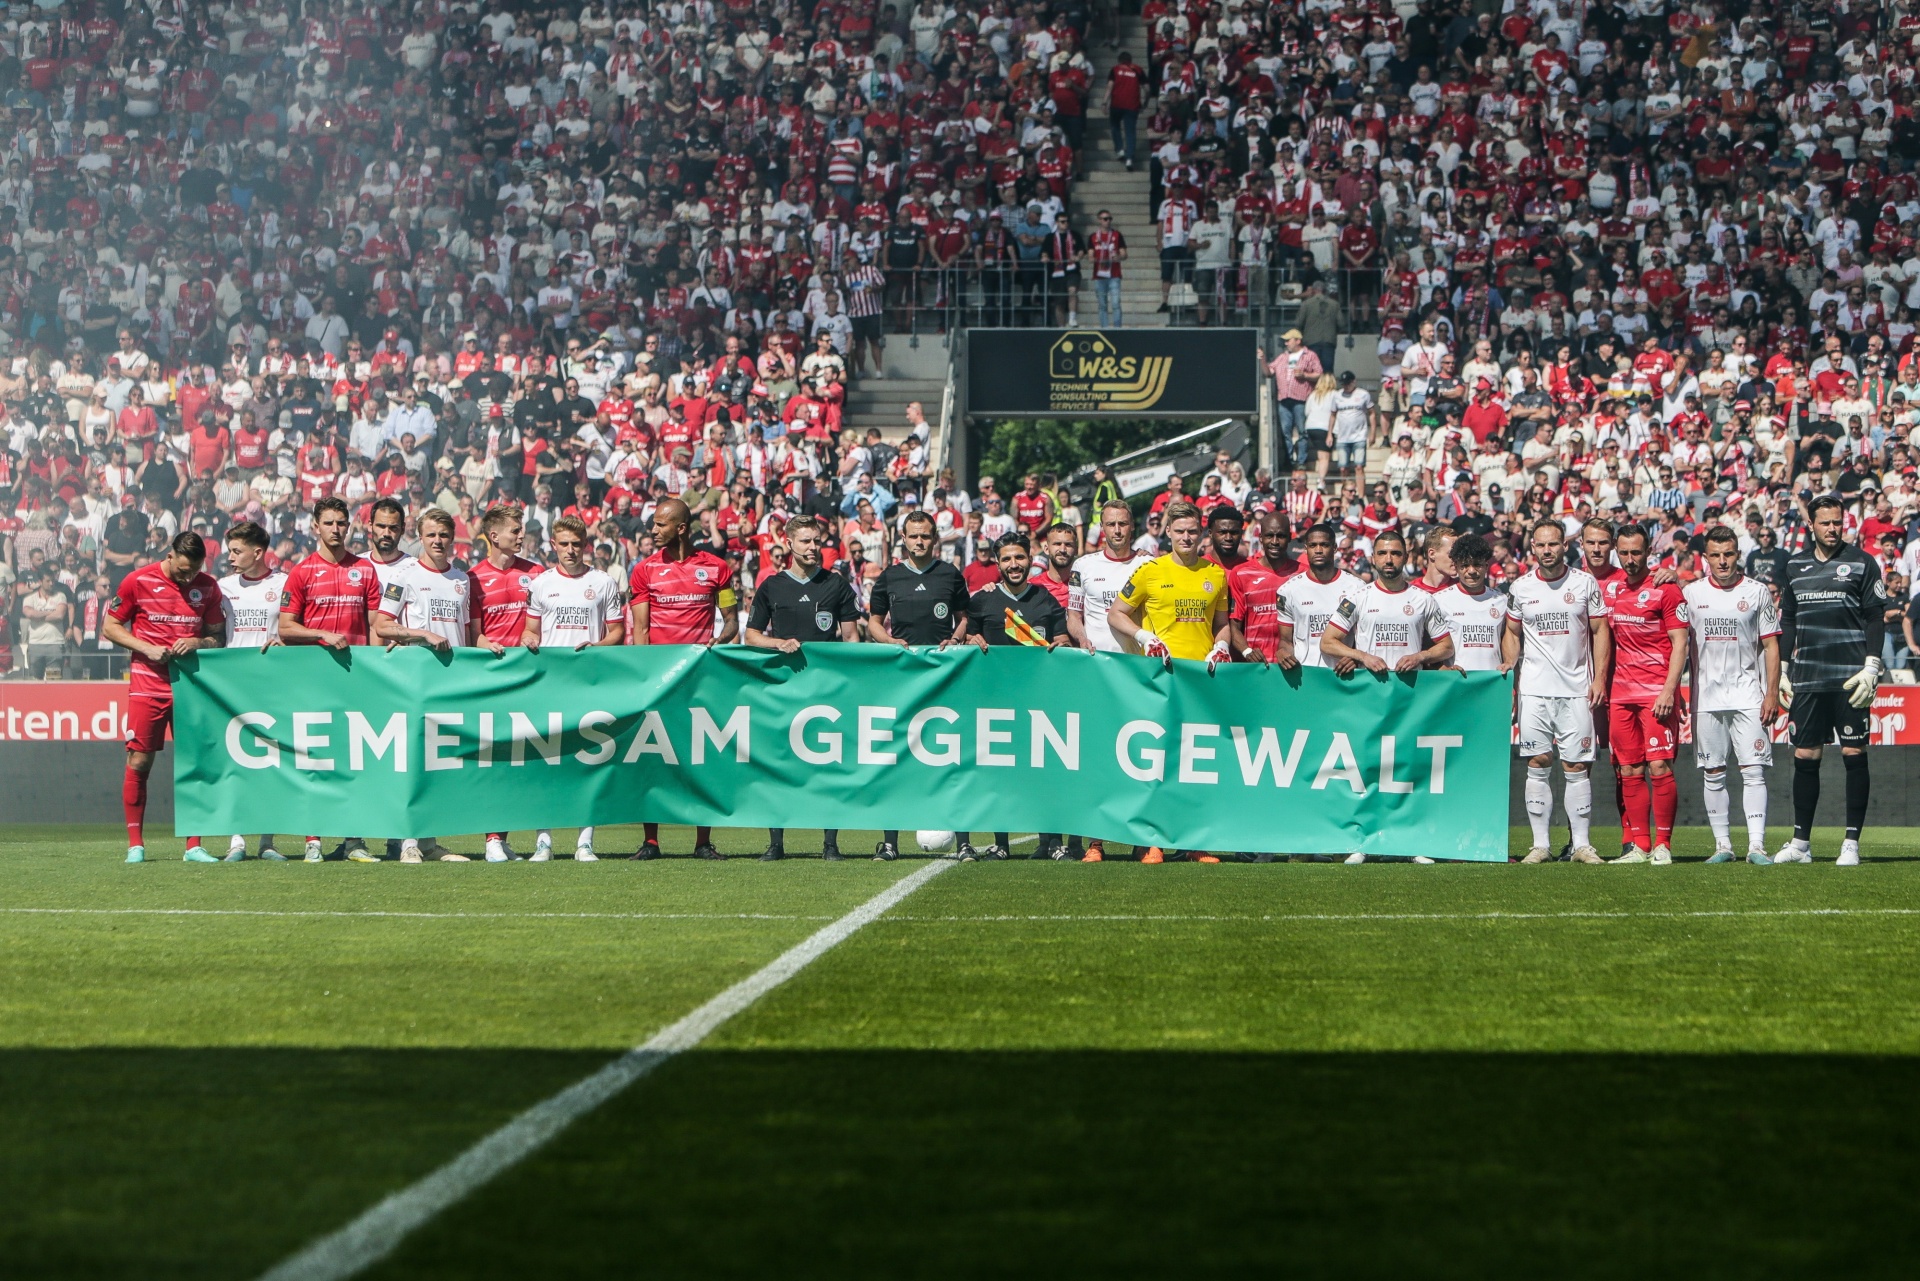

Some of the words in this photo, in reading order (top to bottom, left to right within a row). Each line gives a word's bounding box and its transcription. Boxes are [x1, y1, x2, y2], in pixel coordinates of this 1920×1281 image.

[1078, 356, 1136, 379] W&S
[1050, 383, 1090, 391] TECHNIK
[1050, 393, 1108, 401] CONSULTING
[1050, 402, 1095, 410] SERVICES
[1102, 590, 1119, 600] DEUT
[430, 598, 460, 609] DEUTSCHE
[1174, 599, 1208, 608] DEUTSCHE
[234, 609, 268, 618] DEUTSCHE
[556, 606, 589, 616] DEUTSCHE
[1175, 607, 1206, 617] SAATGUT
[556, 615, 589, 625] SAATGUT
[1309, 613, 1334, 623] DEUTS
[1534, 611, 1569, 622] DEUTSCHE
[1704, 617, 1738, 626] DEUTSCHE
[234, 617, 268, 627] SAATGUT
[1536, 620, 1569, 631] SAATGUT
[1310, 622, 1329, 633] SAAT
[1375, 623, 1409, 632] DEUTSCHE
[1462, 624, 1495, 633] DEUTSCHE
[1704, 626, 1737, 636] SAATGUT
[1375, 632, 1409, 642] SAATGUT
[1462, 633, 1494, 643] SAATGUT
[225, 704, 751, 773] GEMEINSAM
[788, 704, 1079, 771] GEGEN
[1115, 719, 1462, 794] GEWALT
